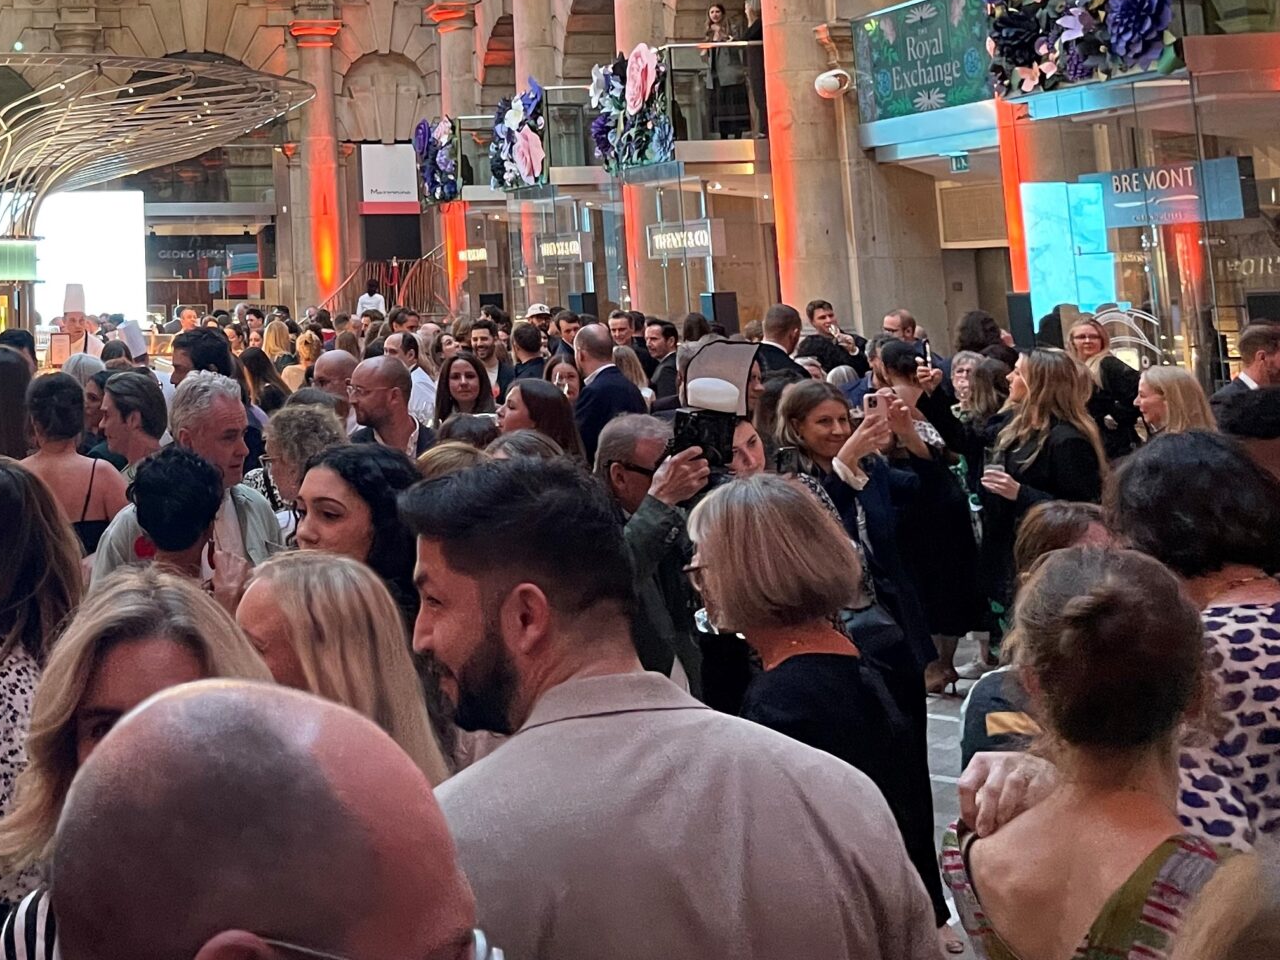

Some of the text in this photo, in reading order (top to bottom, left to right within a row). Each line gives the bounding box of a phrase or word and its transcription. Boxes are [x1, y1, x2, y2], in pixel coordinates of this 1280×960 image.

[906, 28, 943, 64] Royal
[892, 60, 961, 91] Exchange
[1111, 166, 1194, 193] BREMONT
[158, 249, 195, 259] GEORG
